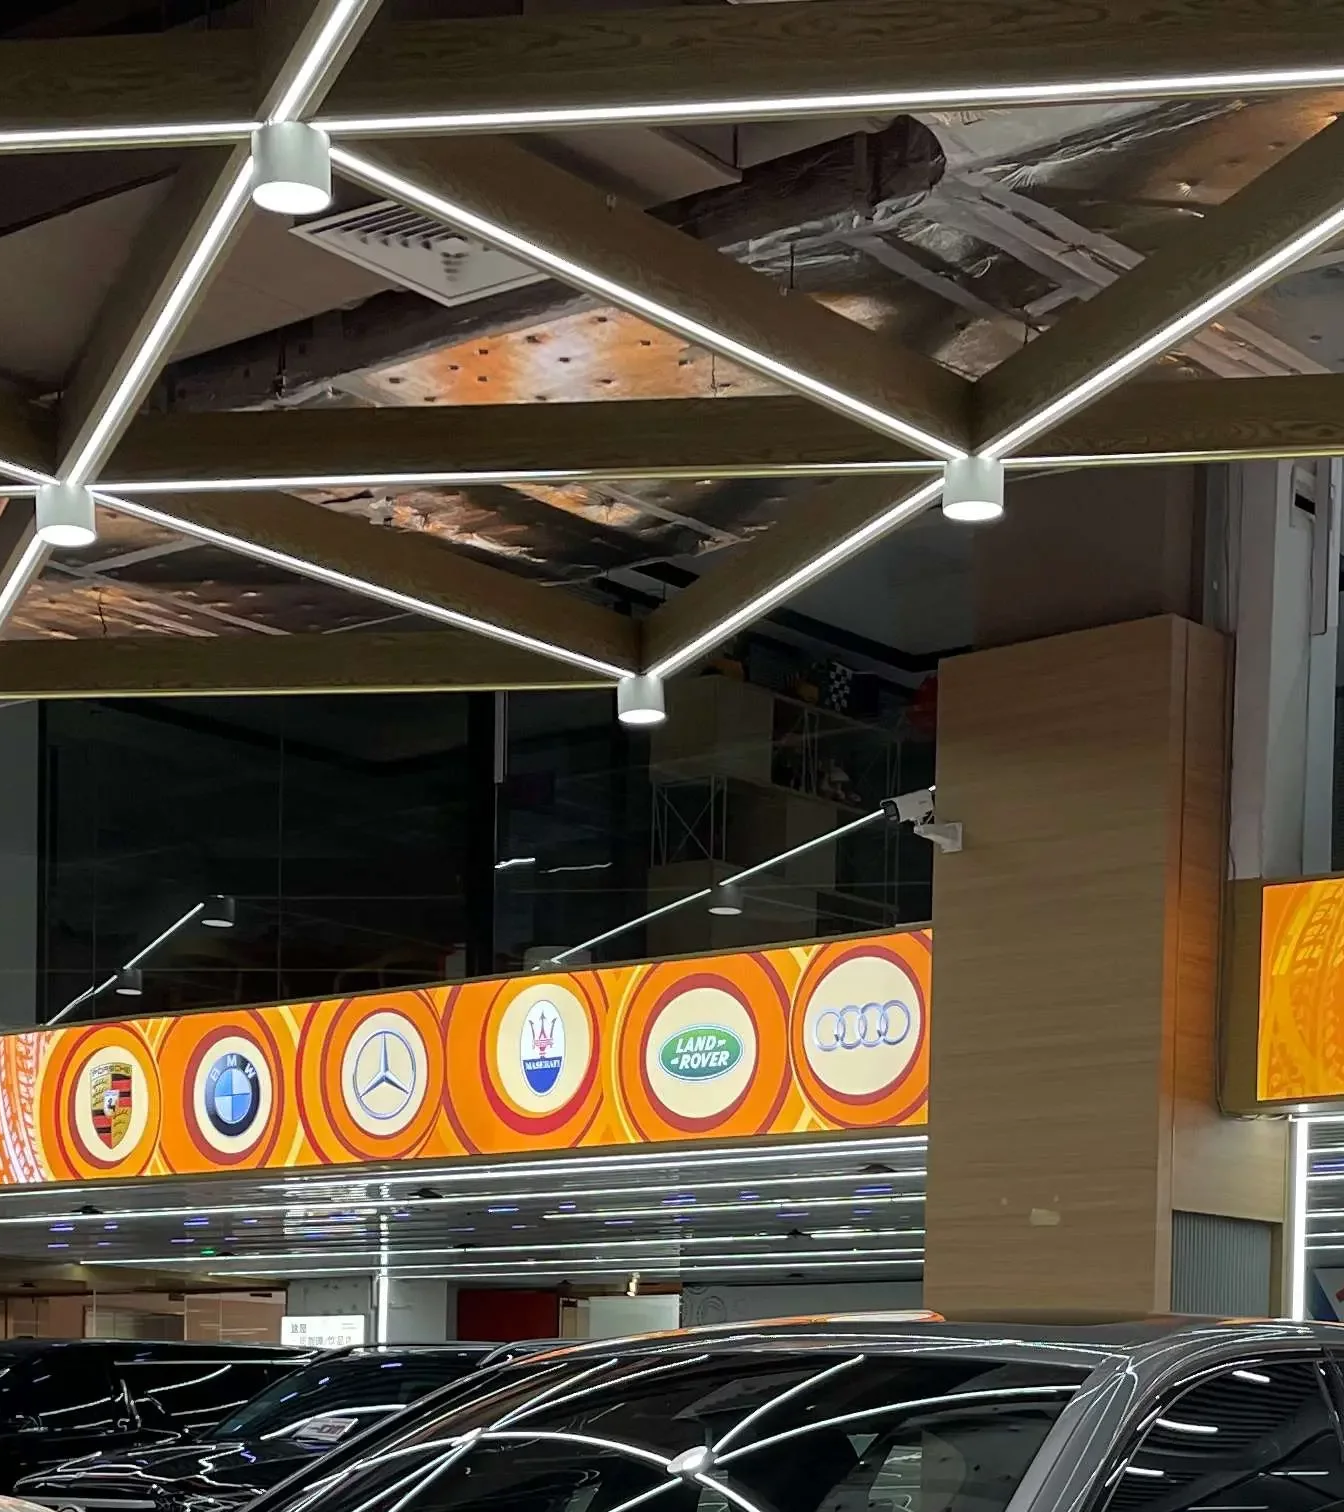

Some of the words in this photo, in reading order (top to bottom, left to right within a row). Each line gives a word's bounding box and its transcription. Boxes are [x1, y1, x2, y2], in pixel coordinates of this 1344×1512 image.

[676, 1036, 716, 1054] LAND
[210, 1053, 256, 1082] BMW
[679, 1051, 730, 1070] ROVER
